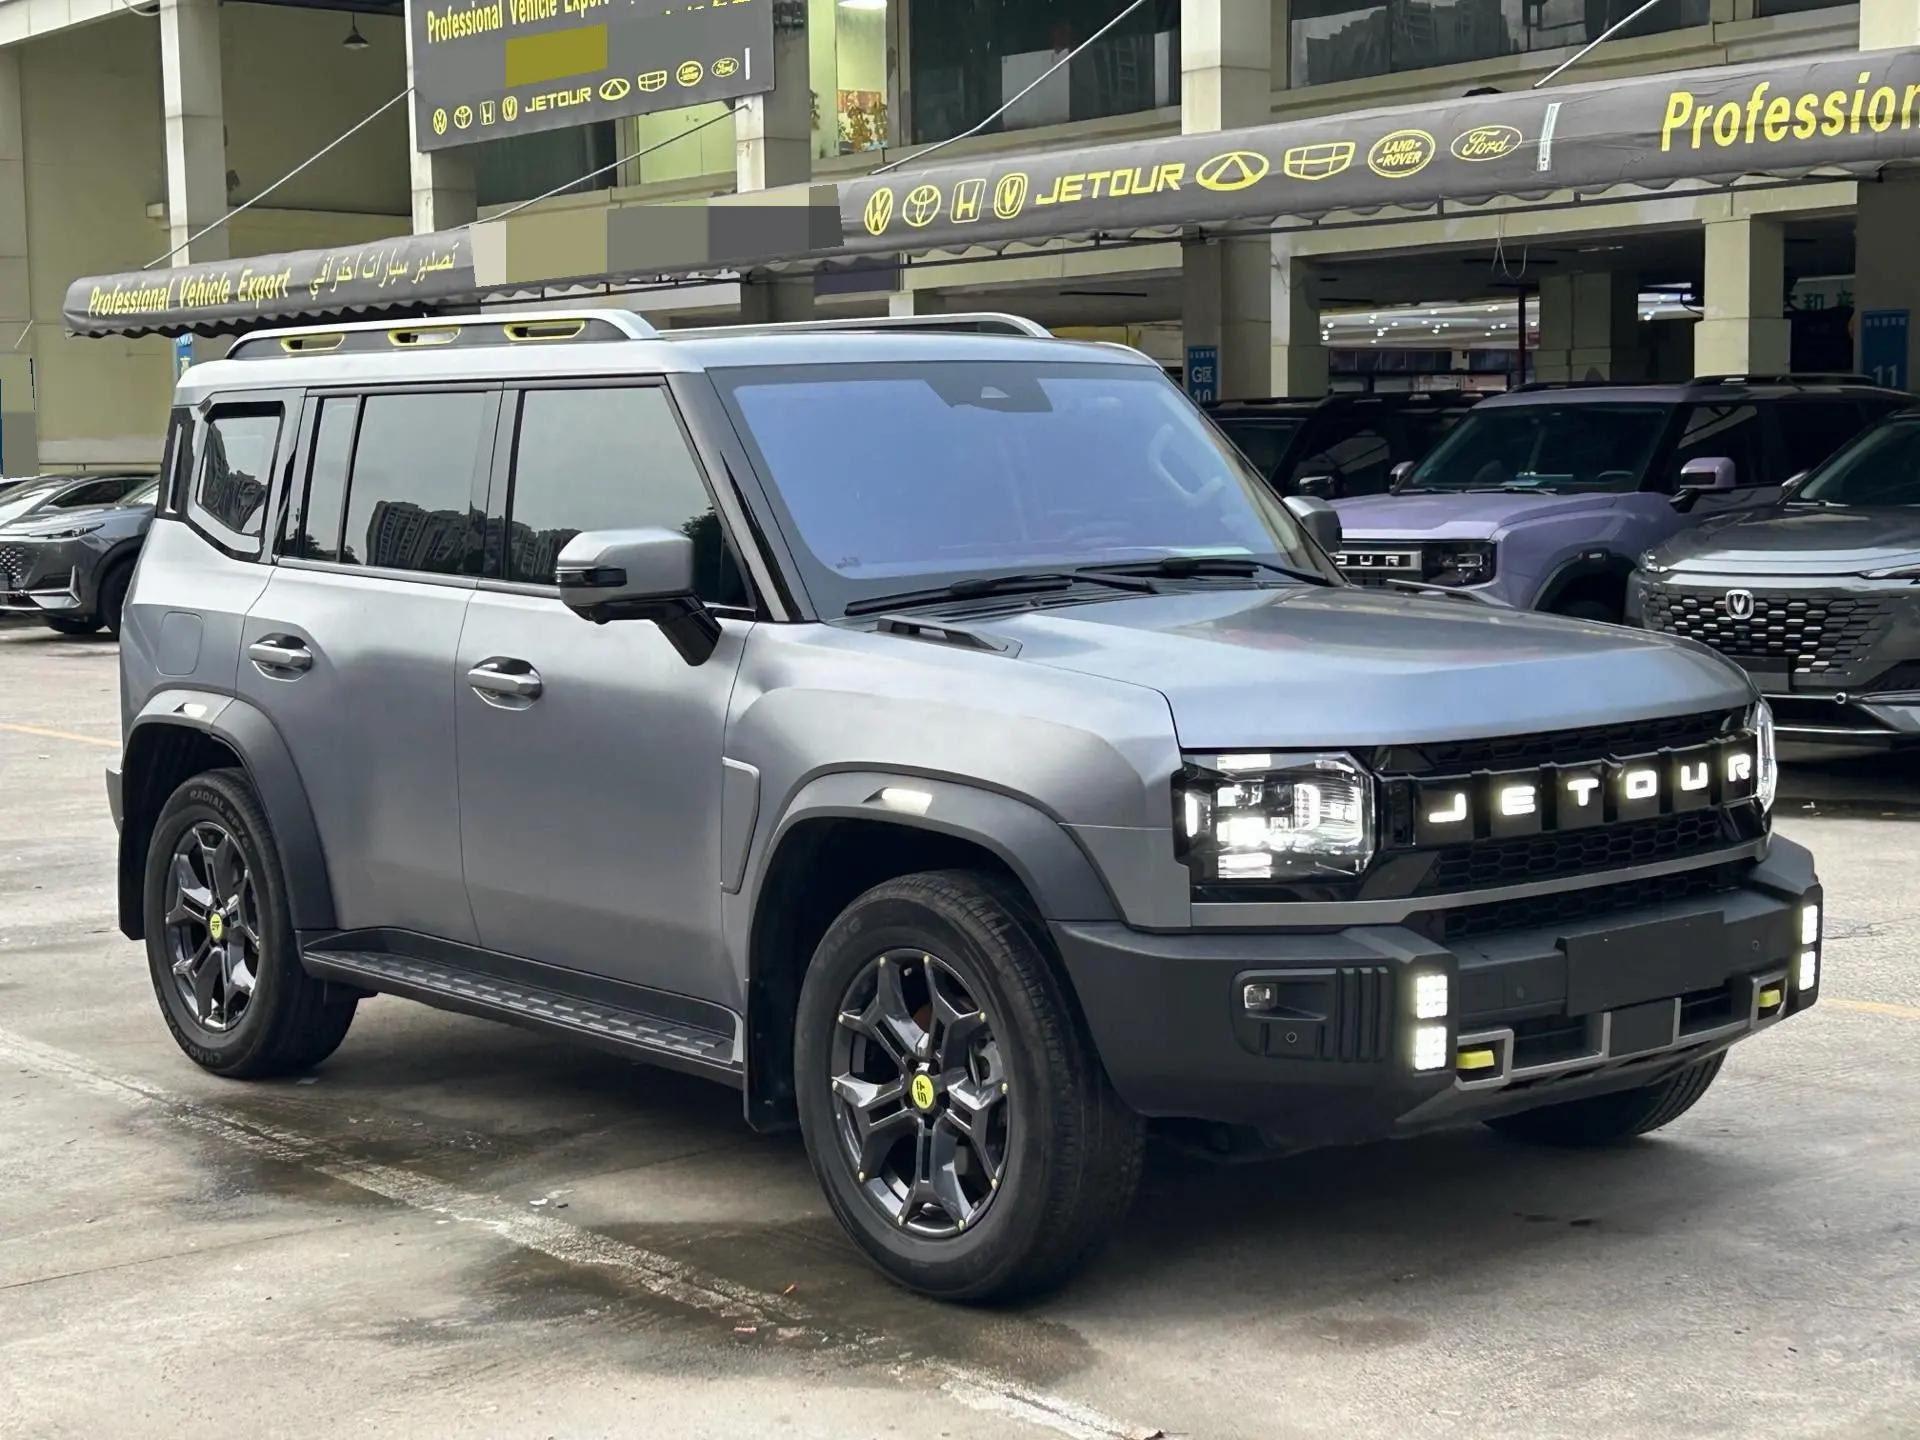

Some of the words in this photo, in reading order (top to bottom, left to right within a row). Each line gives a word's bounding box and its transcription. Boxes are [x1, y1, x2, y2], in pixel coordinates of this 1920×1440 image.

[428, 1, 503, 43] Professional
[525, 87, 591, 113] JETOUR
[1462, 129, 1511, 156] Ford
[1035, 163, 1185, 205] JETOUR
[88, 277, 175, 317] Professional
[180, 271, 231, 309] Vehicle
[238, 267, 291, 309] Export
[1191, 366, 1213, 383] G区
[190, 789, 224, 812] RADIAL
[1428, 753, 1751, 824] JETOUR
